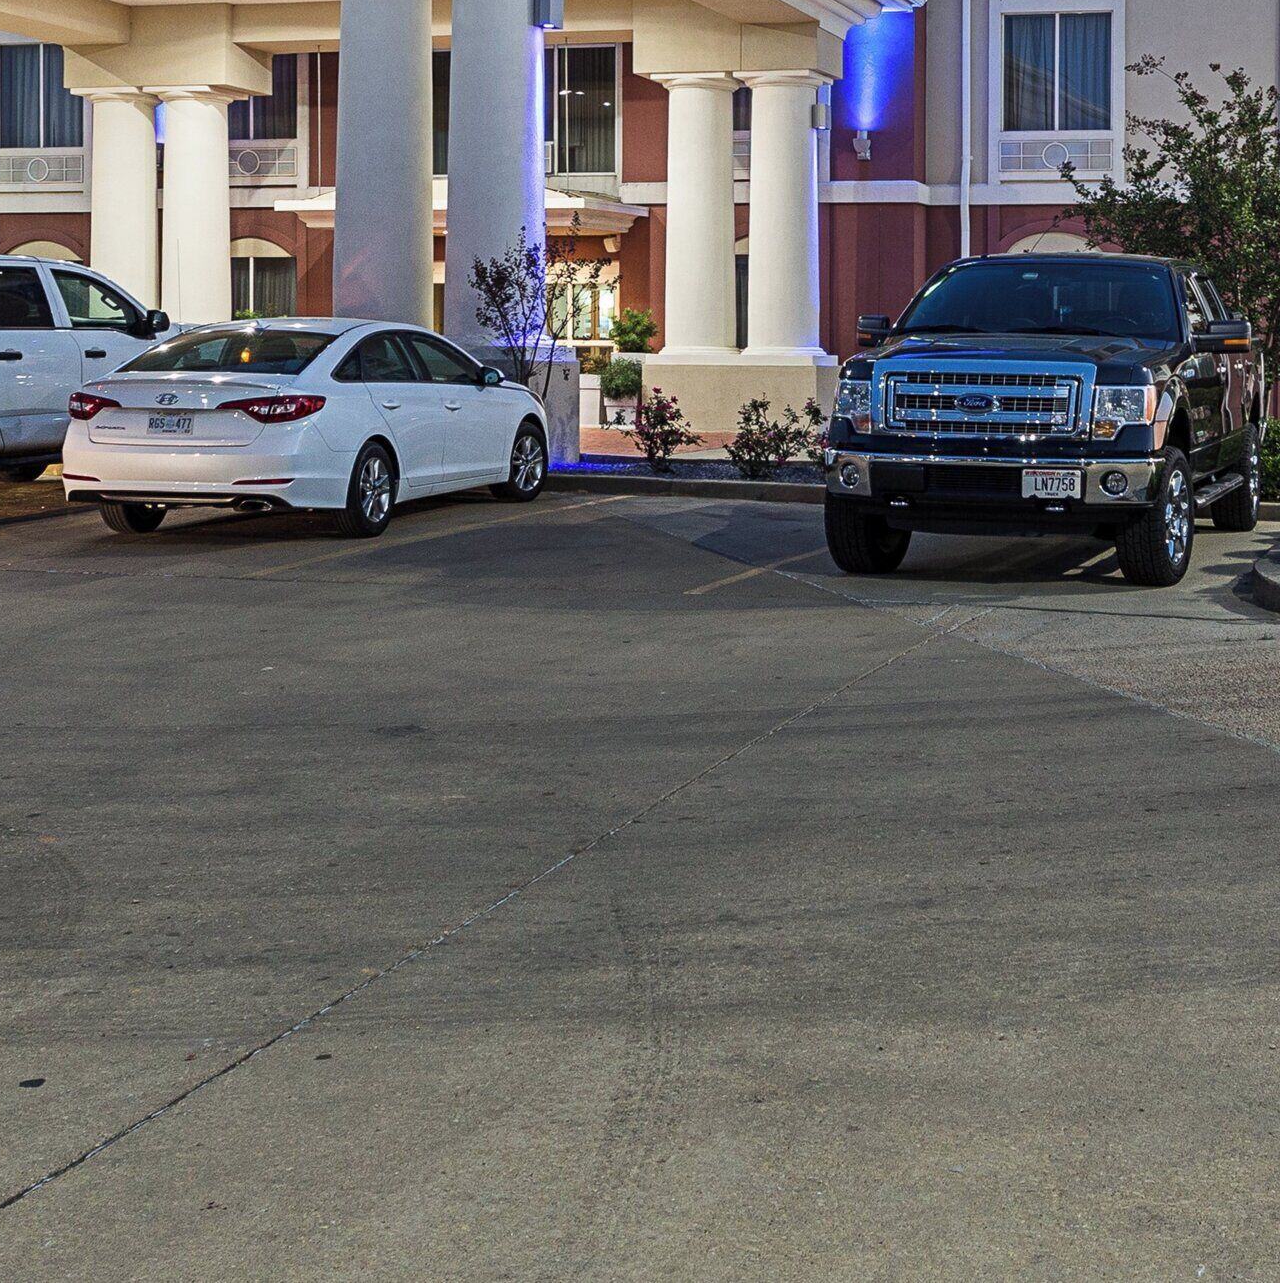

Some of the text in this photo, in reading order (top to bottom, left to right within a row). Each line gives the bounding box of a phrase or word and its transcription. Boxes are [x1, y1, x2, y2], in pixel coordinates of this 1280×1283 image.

[963, 398, 986, 407] Ford
[149, 418, 191, 429] RGS 477
[1034, 477, 1076, 492] LN7758
